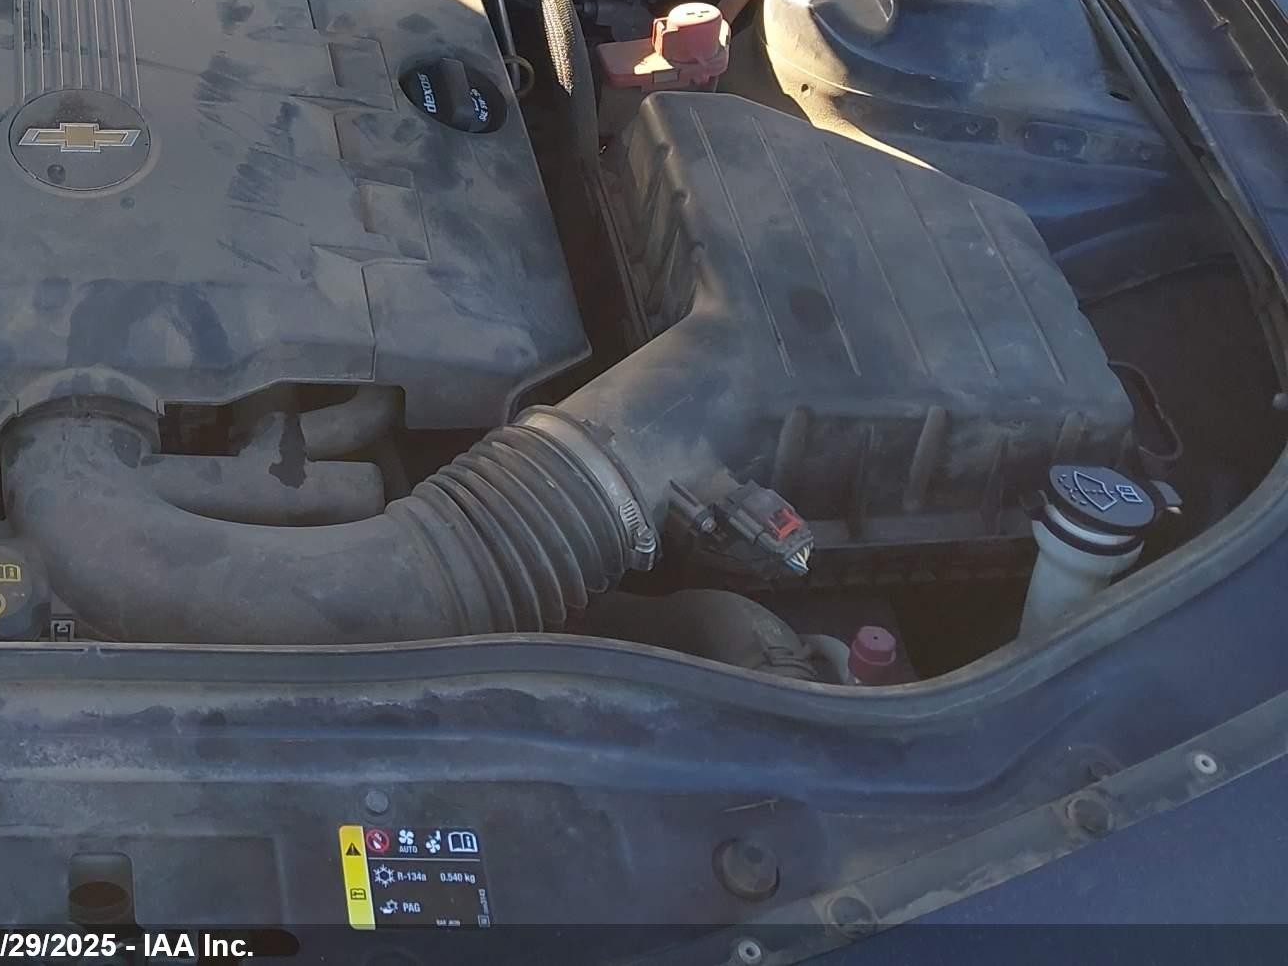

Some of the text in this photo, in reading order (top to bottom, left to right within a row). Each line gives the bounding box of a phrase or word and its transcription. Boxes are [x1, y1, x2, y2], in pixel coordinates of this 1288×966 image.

[418, 73, 437, 113] dexos
[397, 872, 476, 884] R-134a 0.540 kg
[402, 902, 421, 913] PAG
